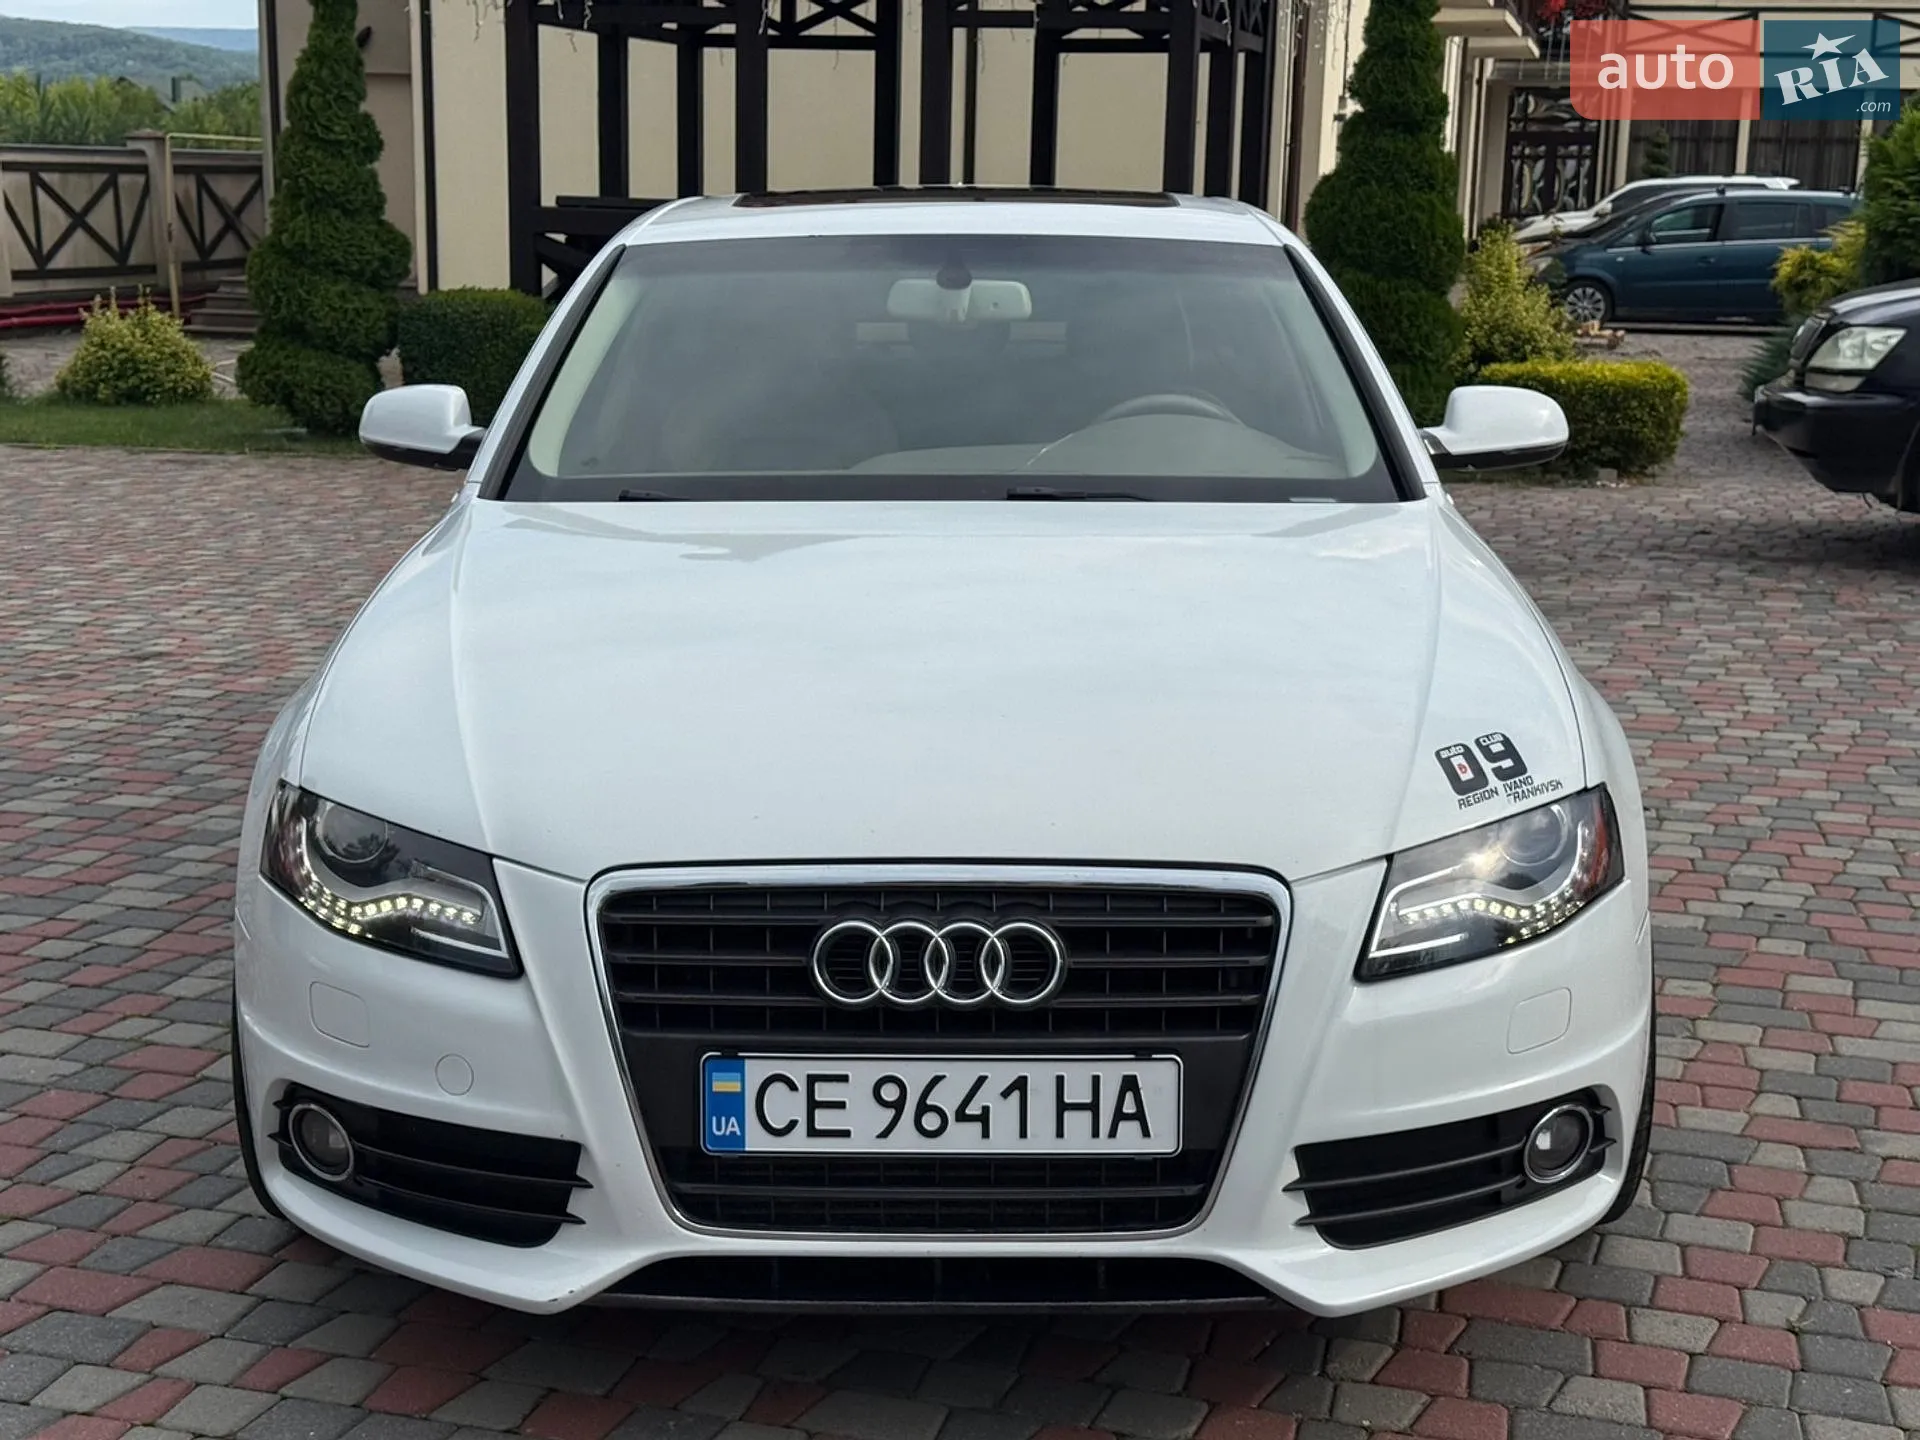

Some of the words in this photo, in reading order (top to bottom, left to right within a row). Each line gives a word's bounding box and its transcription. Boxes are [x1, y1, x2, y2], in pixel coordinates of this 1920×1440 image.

[1457, 786, 1500, 810] REGION
[1502, 775, 1534, 793] IVANO
[754, 1073, 852, 1139] CE
[872, 1073, 1029, 1139] 9641
[1054, 1073, 1153, 1139] HA
[711, 1116, 742, 1137] UA
